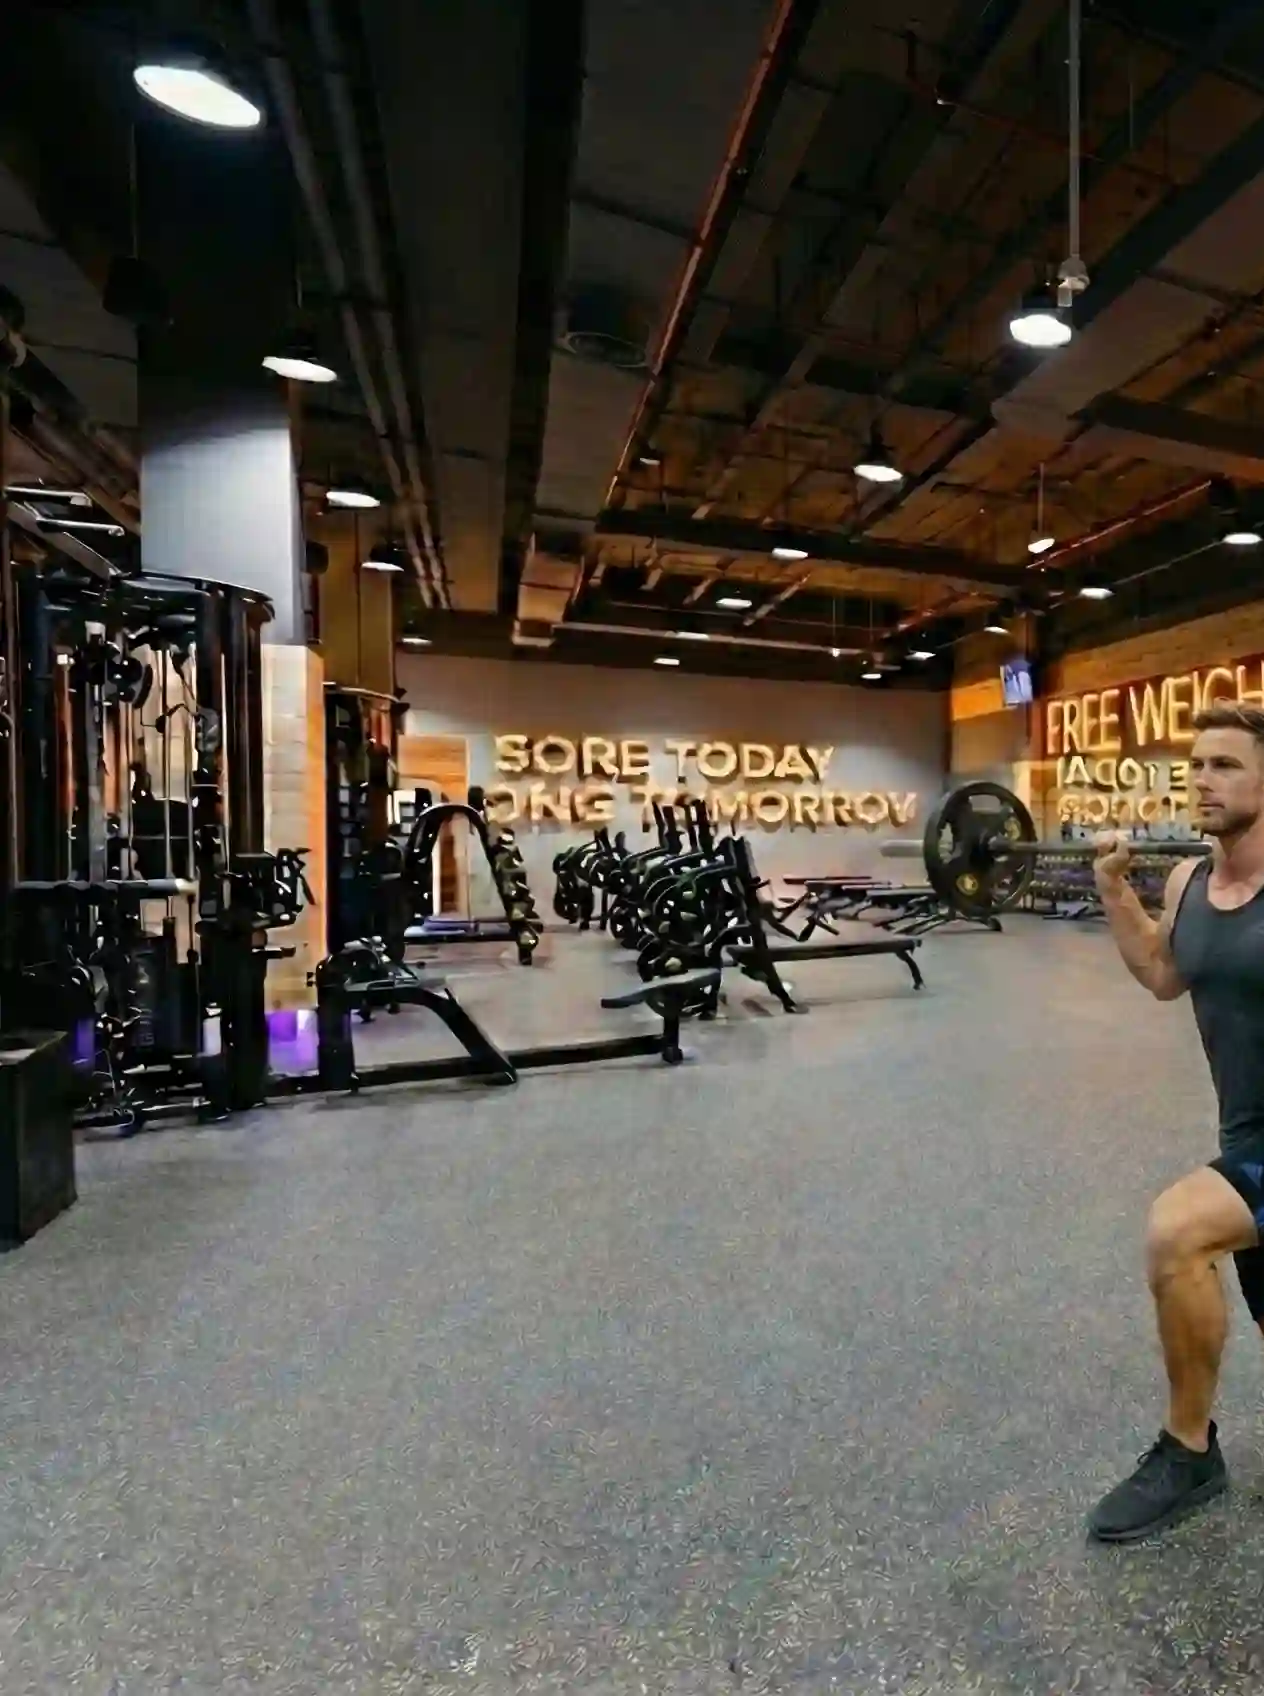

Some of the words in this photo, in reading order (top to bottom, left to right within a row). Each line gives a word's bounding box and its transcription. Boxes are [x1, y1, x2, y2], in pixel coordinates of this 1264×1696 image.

[1047, 688, 1122, 755] FREE
[495, 734, 653, 776] SORE
[664, 738, 835, 780] TODAY
